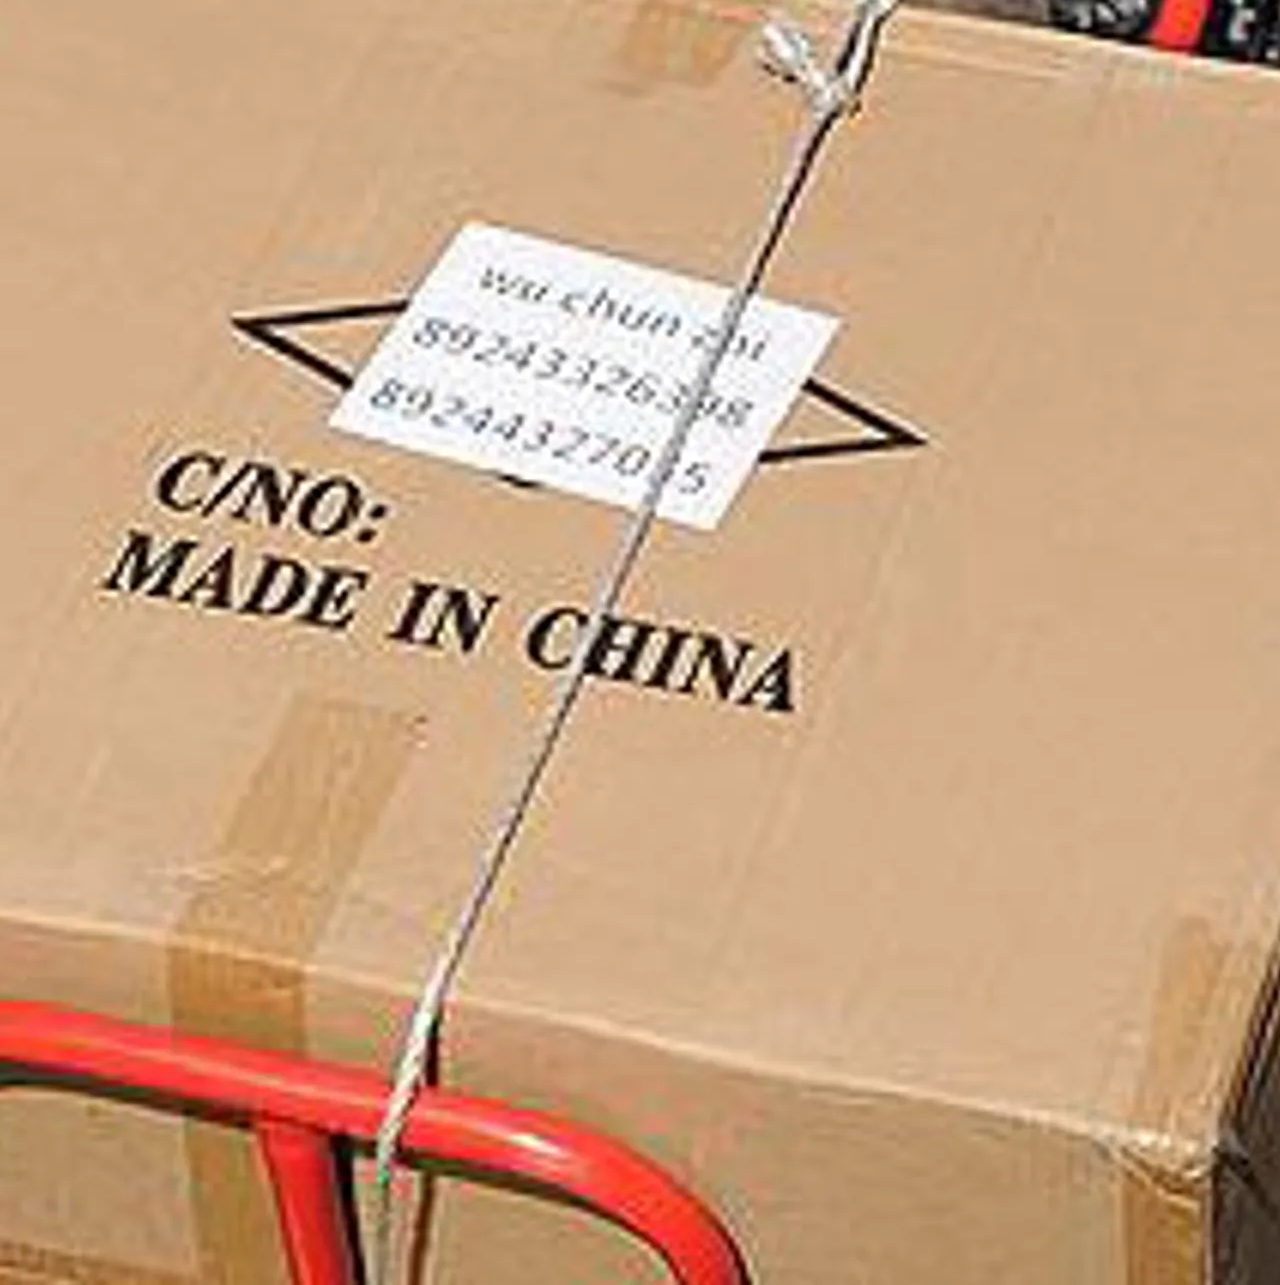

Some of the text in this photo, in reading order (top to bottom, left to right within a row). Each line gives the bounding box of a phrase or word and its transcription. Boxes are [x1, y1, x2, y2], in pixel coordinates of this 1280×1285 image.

[479, 266, 548, 306] wu
[560, 286, 679, 339] chun
[369, 379, 713, 497] 8924432705
[155, 451, 389, 544] C/NO:
[102, 529, 796, 714] MADE IN CHINA
